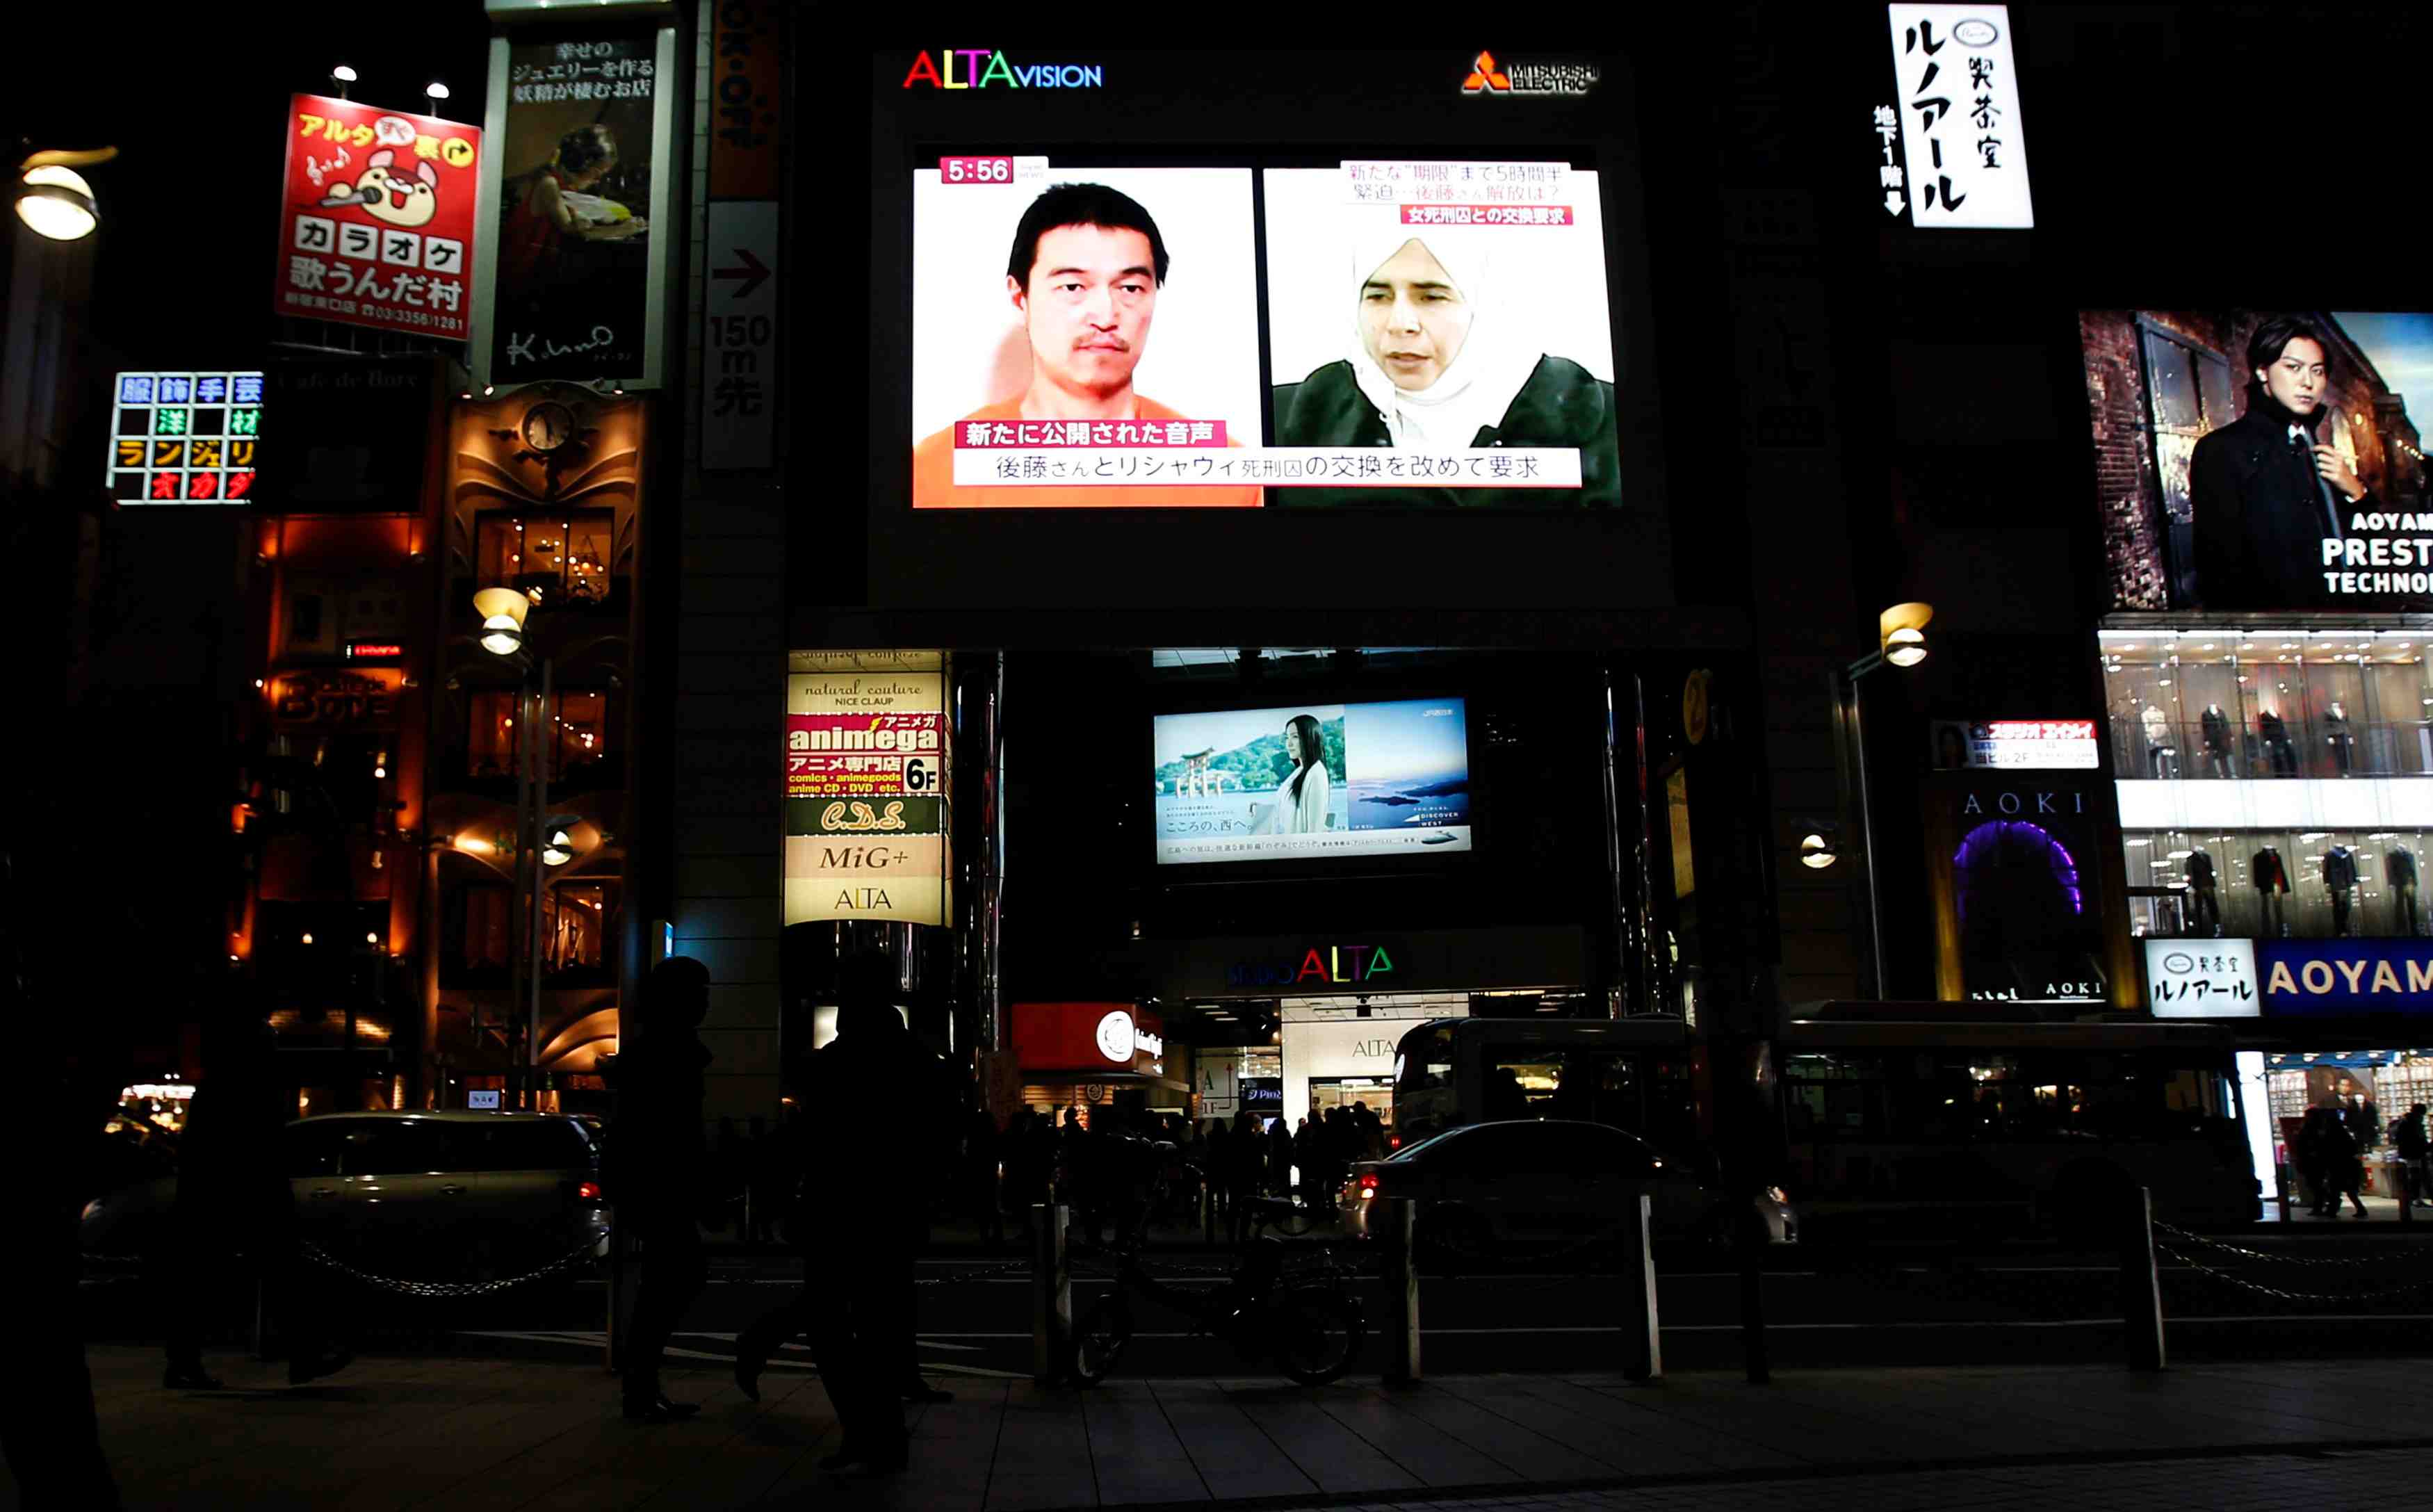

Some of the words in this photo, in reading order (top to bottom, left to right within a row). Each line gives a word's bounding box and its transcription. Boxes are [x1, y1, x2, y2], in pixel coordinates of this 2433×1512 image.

[902, 49, 1019, 89] ALTA
[1014, 65, 1102, 87] VISION
[1511, 78, 1587, 92] ELECTRIC
[1905, 19, 1967, 211] ルノアール
[1873, 104, 1903, 188] 地下1階
[949, 160, 1008, 181] 5:56
[303, 221, 457, 266] カラオケ
[289, 256, 463, 312] 歌うんだ村
[121, 377, 263, 403] 服飾手芸
[966, 422, 1214, 446] 新たに公開された音声
[2322, 537, 2433, 567] PREST
[805, 678, 861, 696] natural
[867, 682, 923, 695] couture
[835, 697, 859, 706] NICE
[861, 697, 894, 706] CLAUP
[884, 715, 936, 729] アニメガ
[789, 726, 938, 751] animega
[788, 756, 902, 772] アニメ専門店
[906, 758, 936, 790] 6F
[789, 773, 827, 783] comics
[836, 773, 902, 783] animegoods
[789, 783, 822, 793] anime
[823, 783, 840, 792] CD
[849, 783, 874, 792] DVD
[879, 783, 901, 792] etc.
[1964, 792, 2083, 814] AOKI
[820, 846, 909, 868] MiG+
[834, 887, 892, 910] ALTA
[1296, 945, 1397, 985] ALTA
[2046, 982, 2101, 994] AOKI
[2267, 959, 2433, 995] AOYAM
[2154, 979, 2253, 1002] ルノアール
[1352, 1039, 1397, 1057] ALTA
